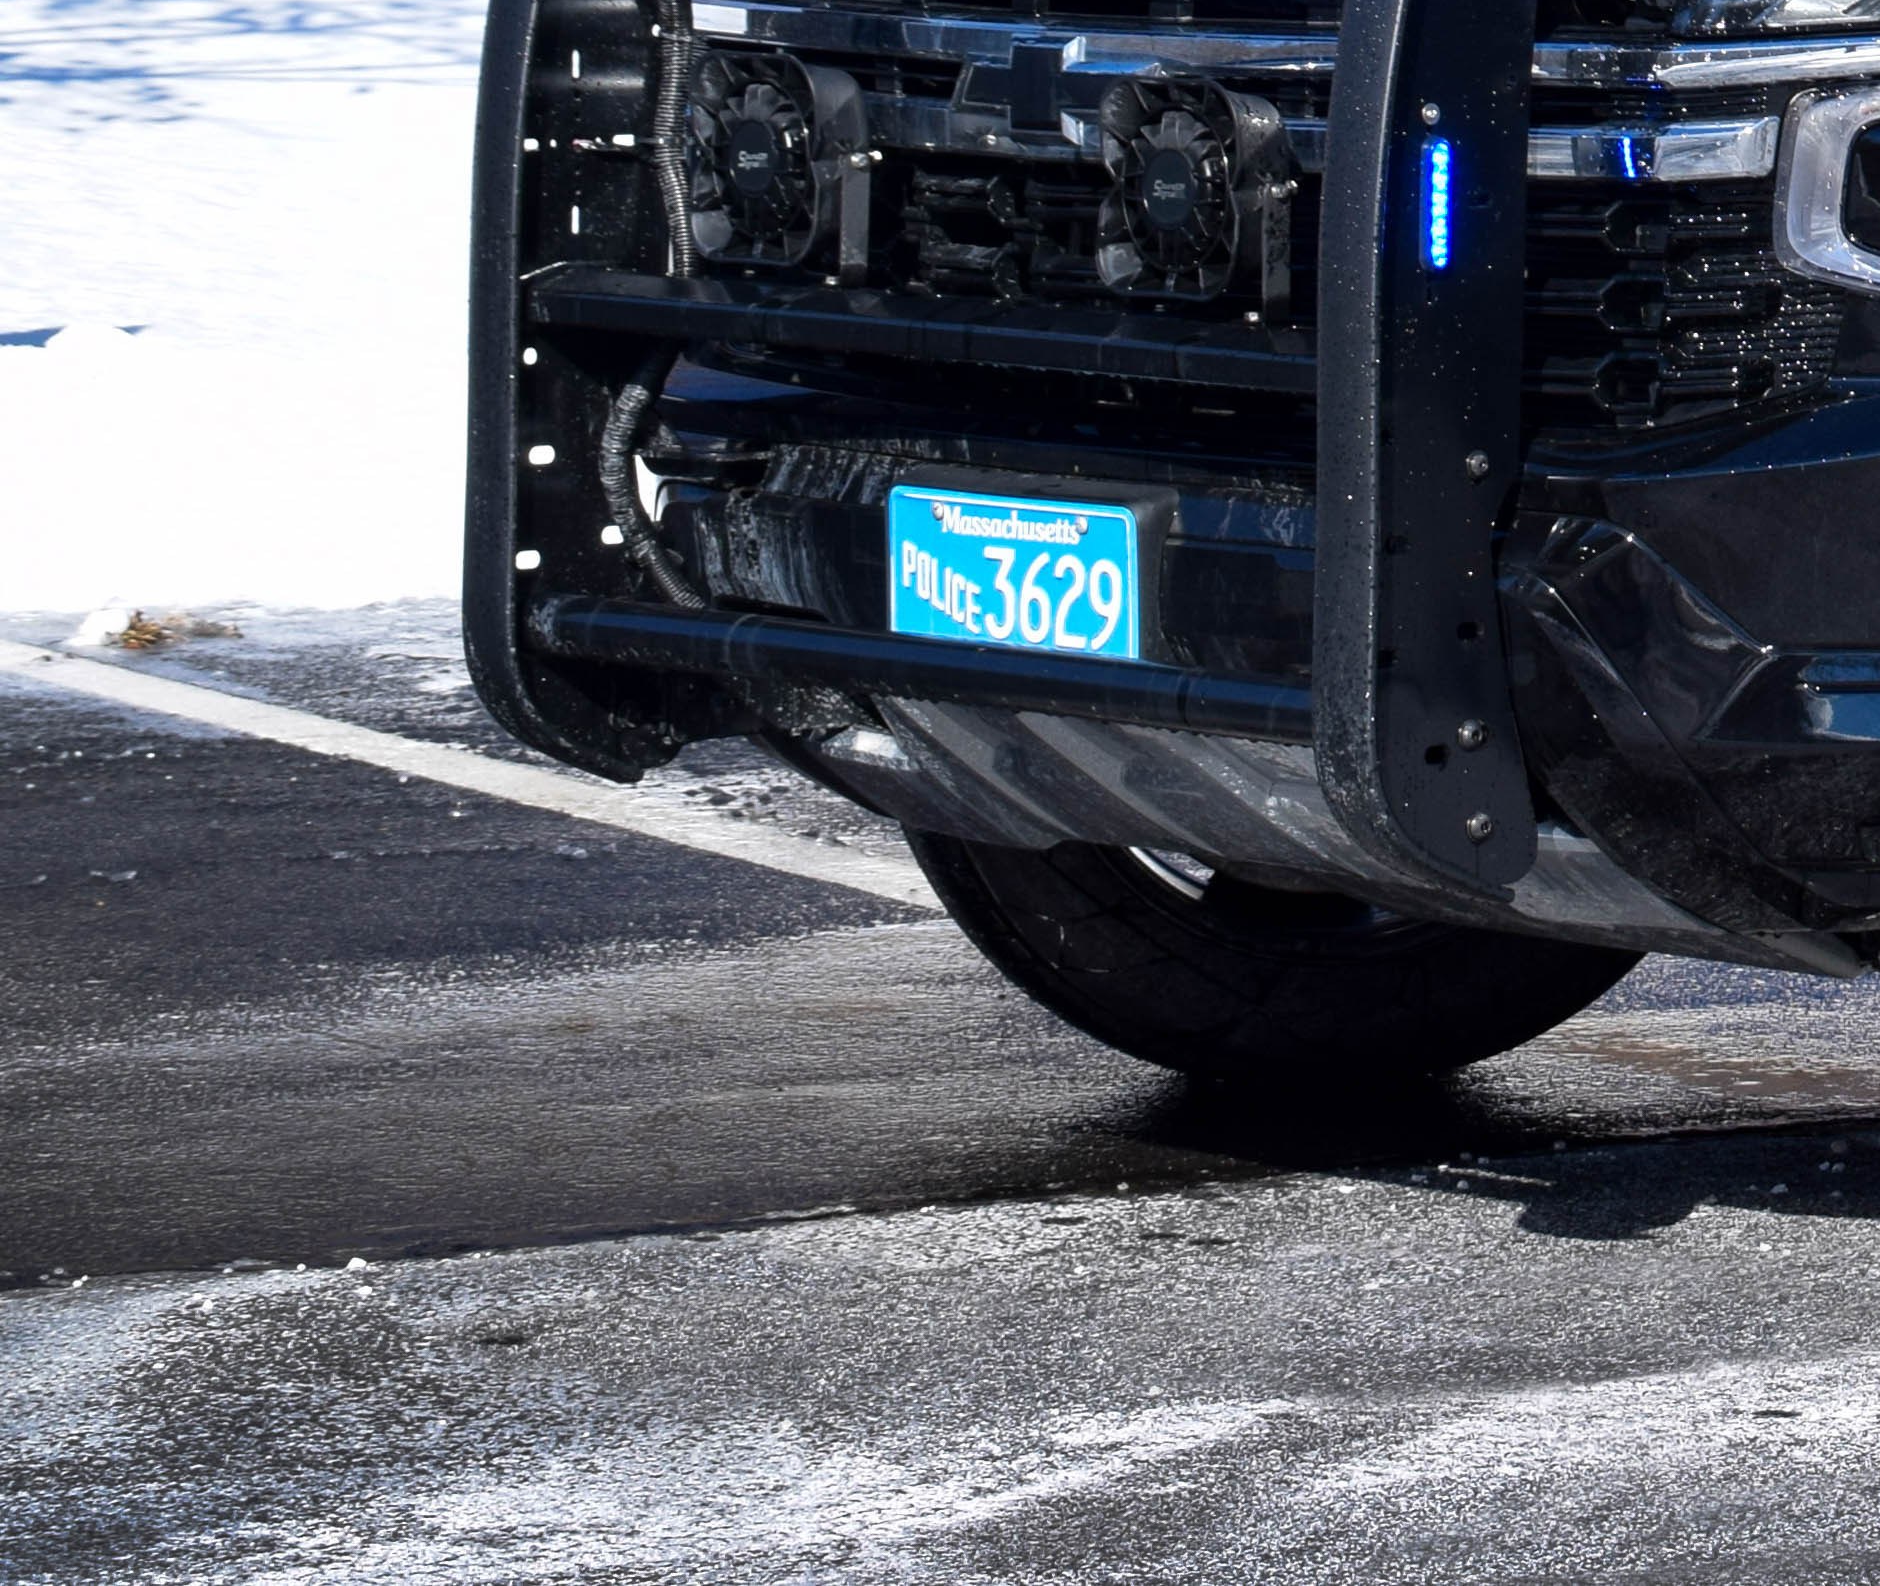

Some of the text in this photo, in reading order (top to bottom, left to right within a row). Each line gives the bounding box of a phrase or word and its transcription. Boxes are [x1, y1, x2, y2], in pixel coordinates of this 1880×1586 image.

[941, 504, 1081, 545] Massachusetts
[901, 539, 1123, 650] POLICE 3629
